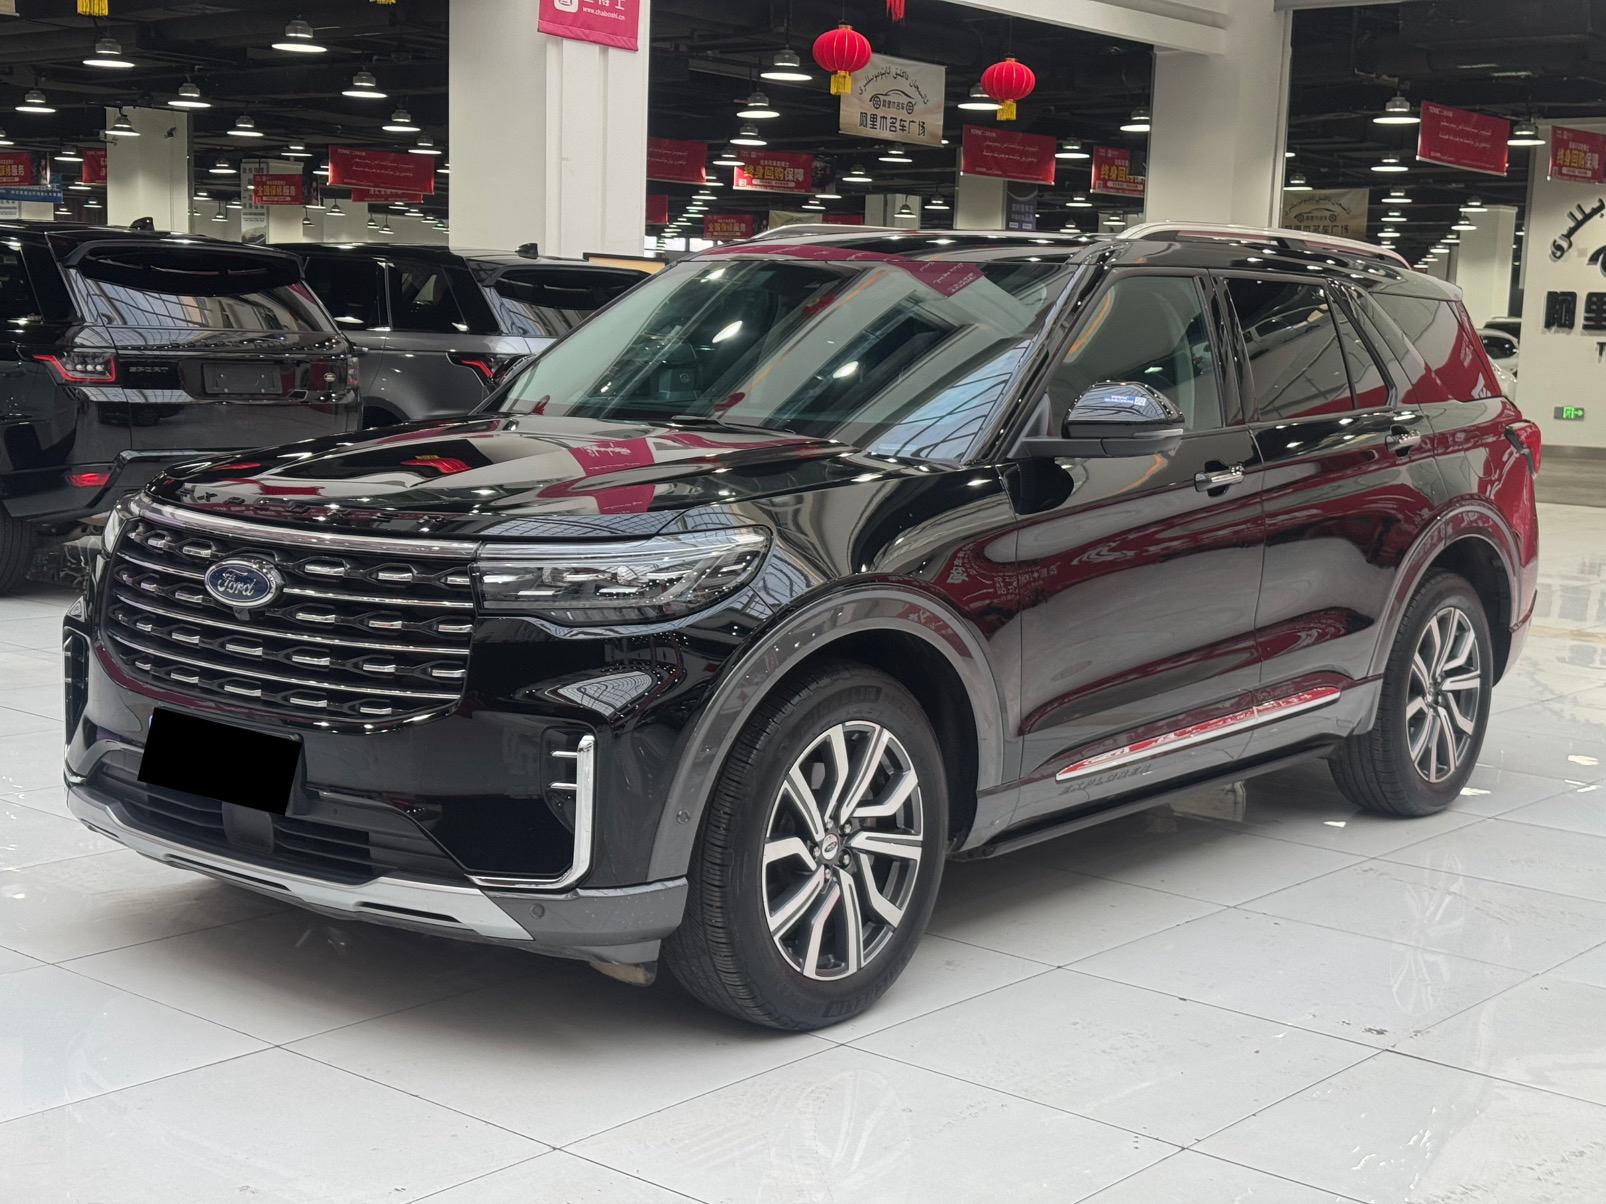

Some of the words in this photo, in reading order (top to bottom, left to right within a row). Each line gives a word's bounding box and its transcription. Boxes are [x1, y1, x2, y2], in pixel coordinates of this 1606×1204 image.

[859, 111, 926, 136] 阿里木名车广场
[743, 165, 804, 182] 终身回购保障
[217, 568, 256, 595] Ford
